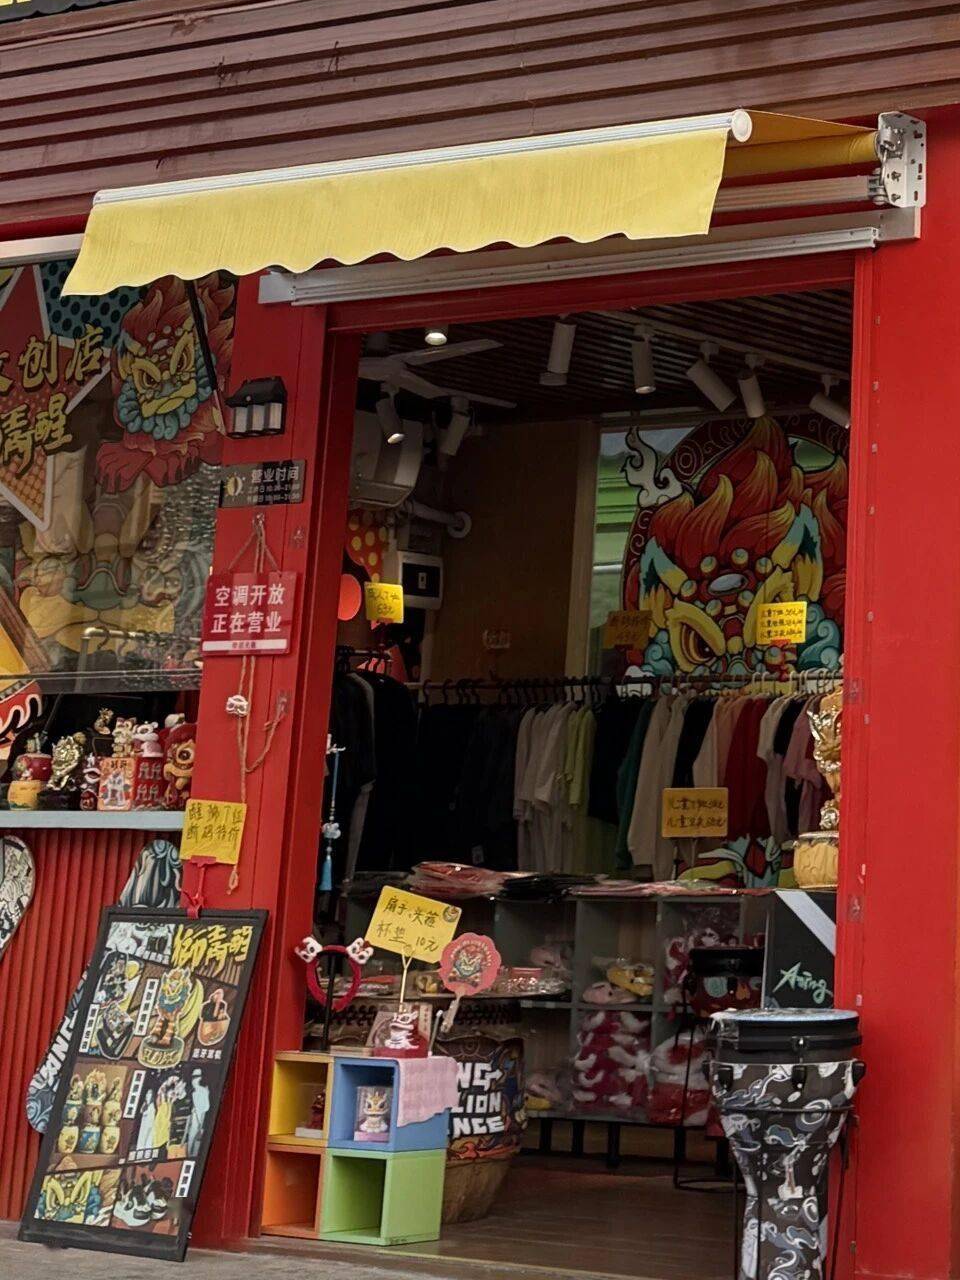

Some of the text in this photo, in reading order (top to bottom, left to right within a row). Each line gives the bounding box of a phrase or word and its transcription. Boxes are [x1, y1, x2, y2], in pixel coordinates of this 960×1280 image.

[0, 393, 73, 474] 青醒
[251, 466, 299, 483] 营业时间
[214, 583, 286, 607] 空调开放
[211, 611, 282, 634] 正在营业
[453, 1116, 504, 1140] NCE
